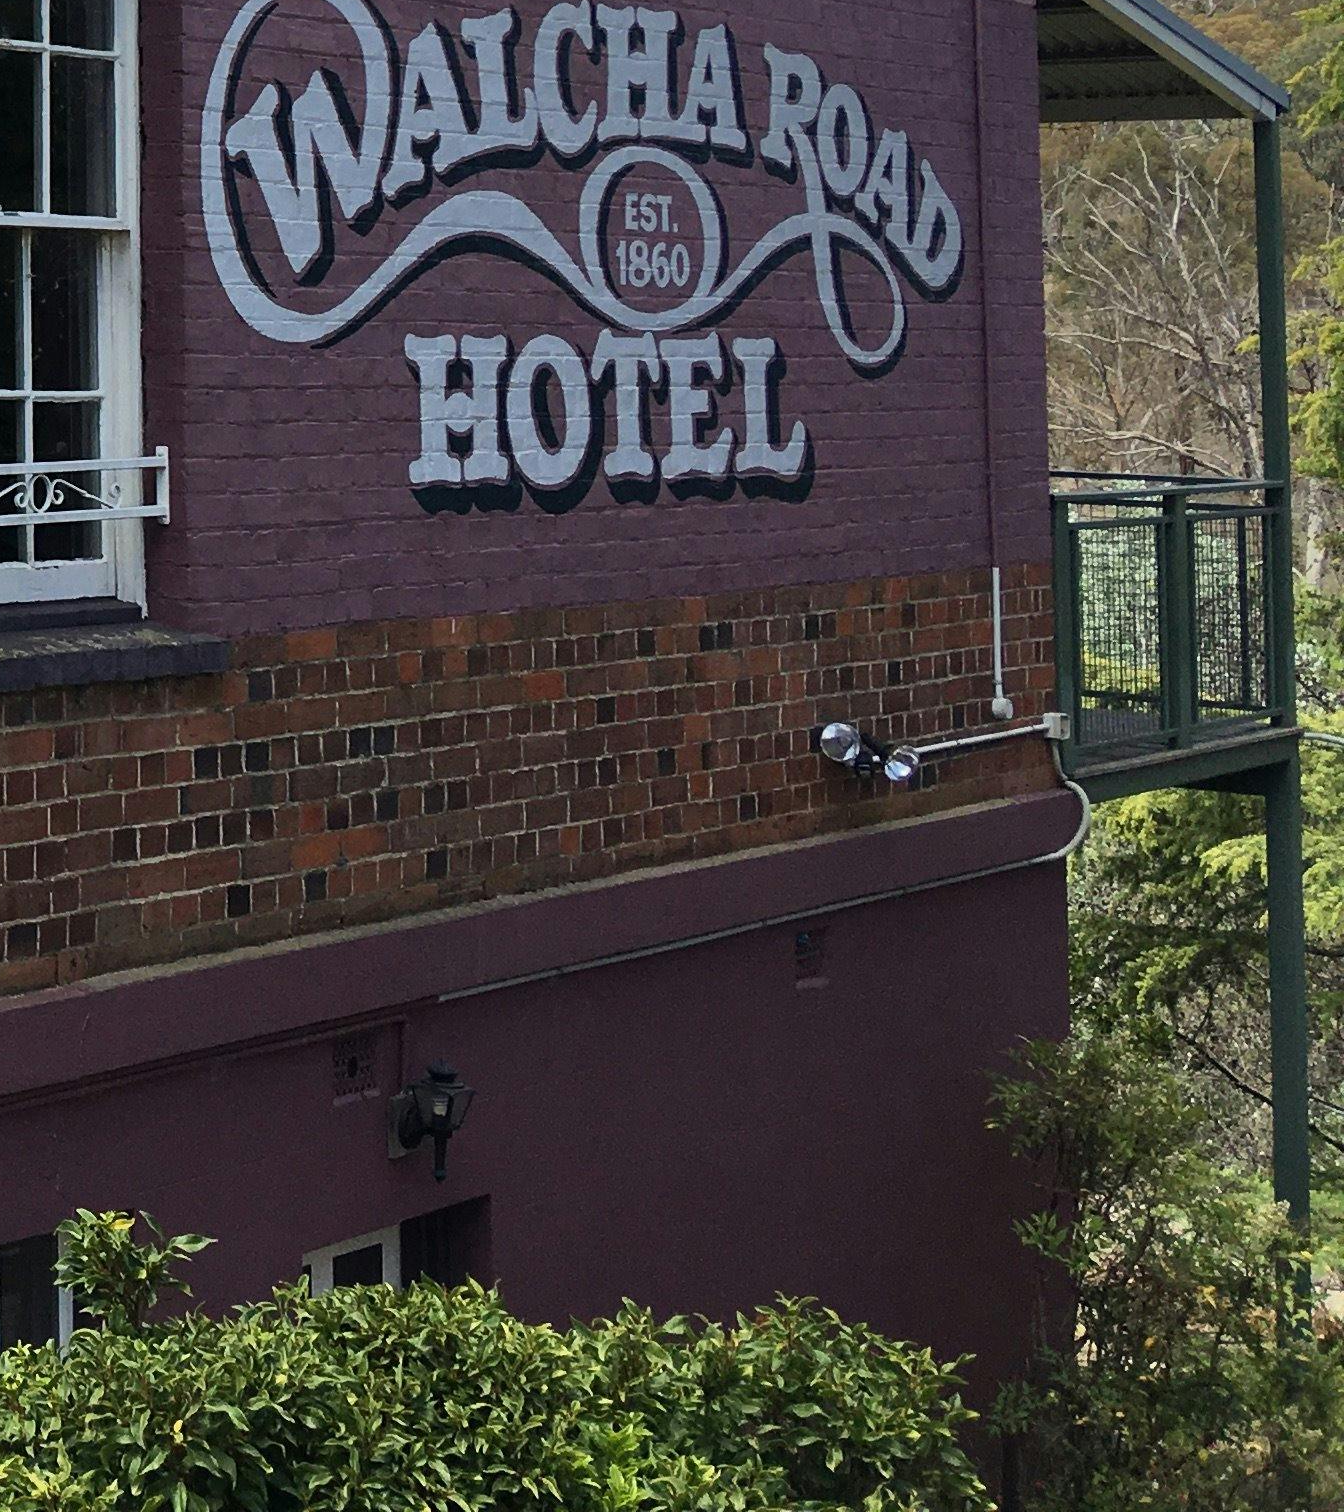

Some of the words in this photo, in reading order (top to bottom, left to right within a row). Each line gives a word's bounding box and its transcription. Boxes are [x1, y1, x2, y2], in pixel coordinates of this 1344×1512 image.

[624, 191, 679, 234] EST.
[763, 42, 965, 303] ROAD
[615, 240, 690, 288] 1860
[404, 331, 811, 500] HOTEL
